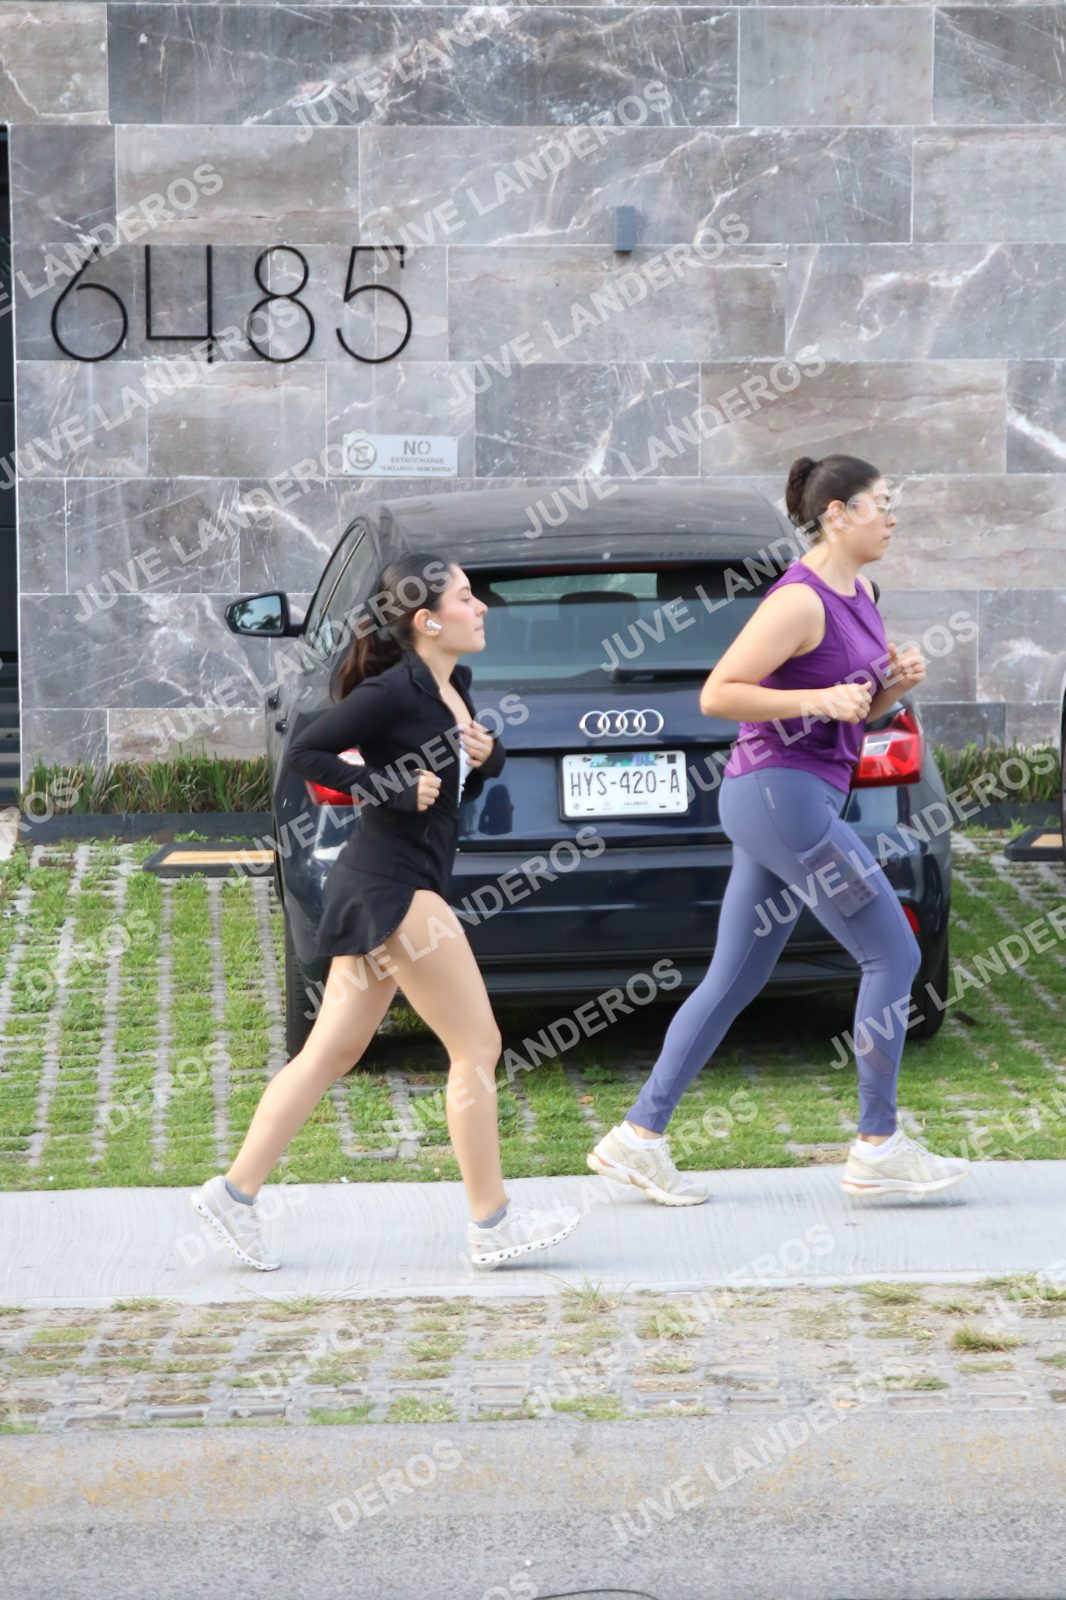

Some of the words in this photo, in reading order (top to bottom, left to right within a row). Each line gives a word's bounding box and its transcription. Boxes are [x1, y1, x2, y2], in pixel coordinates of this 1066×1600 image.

[51, 244, 412, 363] 6485
[403, 440, 432, 456] NO
[570, 768, 680, 797] HYS-420-A
